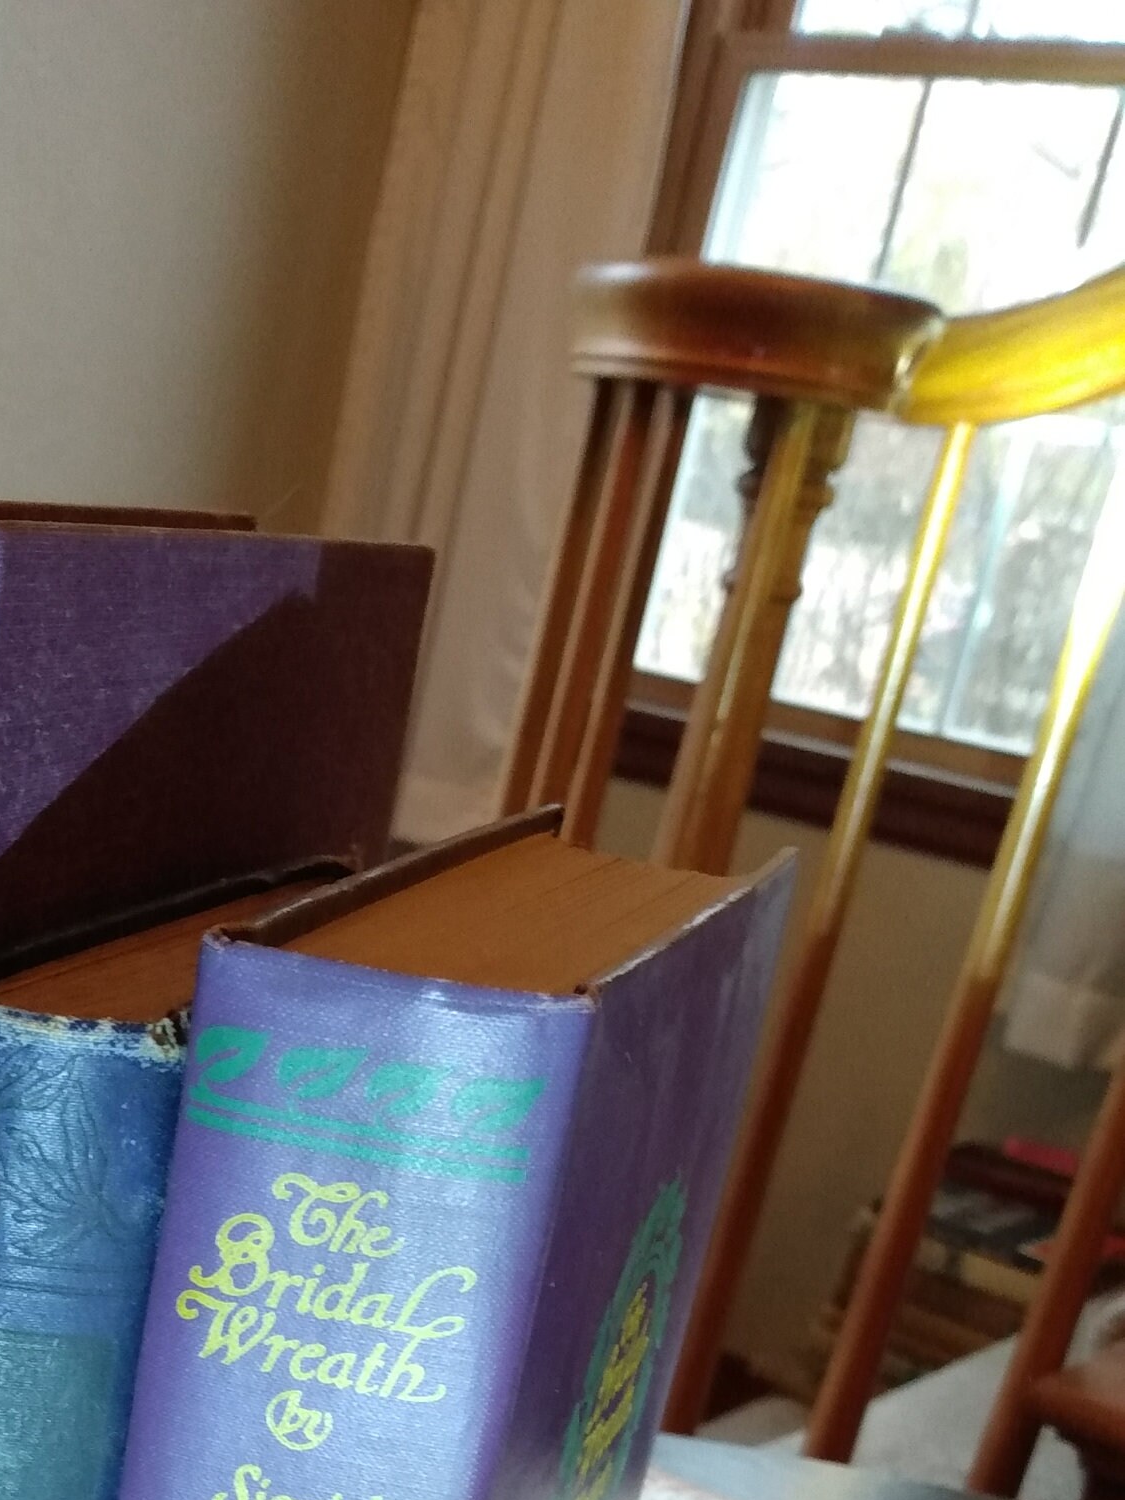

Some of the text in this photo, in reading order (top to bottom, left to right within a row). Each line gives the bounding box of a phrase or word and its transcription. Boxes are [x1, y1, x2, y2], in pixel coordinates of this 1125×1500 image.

[272, 1172, 405, 1259] The
[188, 1212, 477, 1340] Bridal
[176, 1290, 447, 1404] Wreath
[266, 1389, 334, 1451] by
